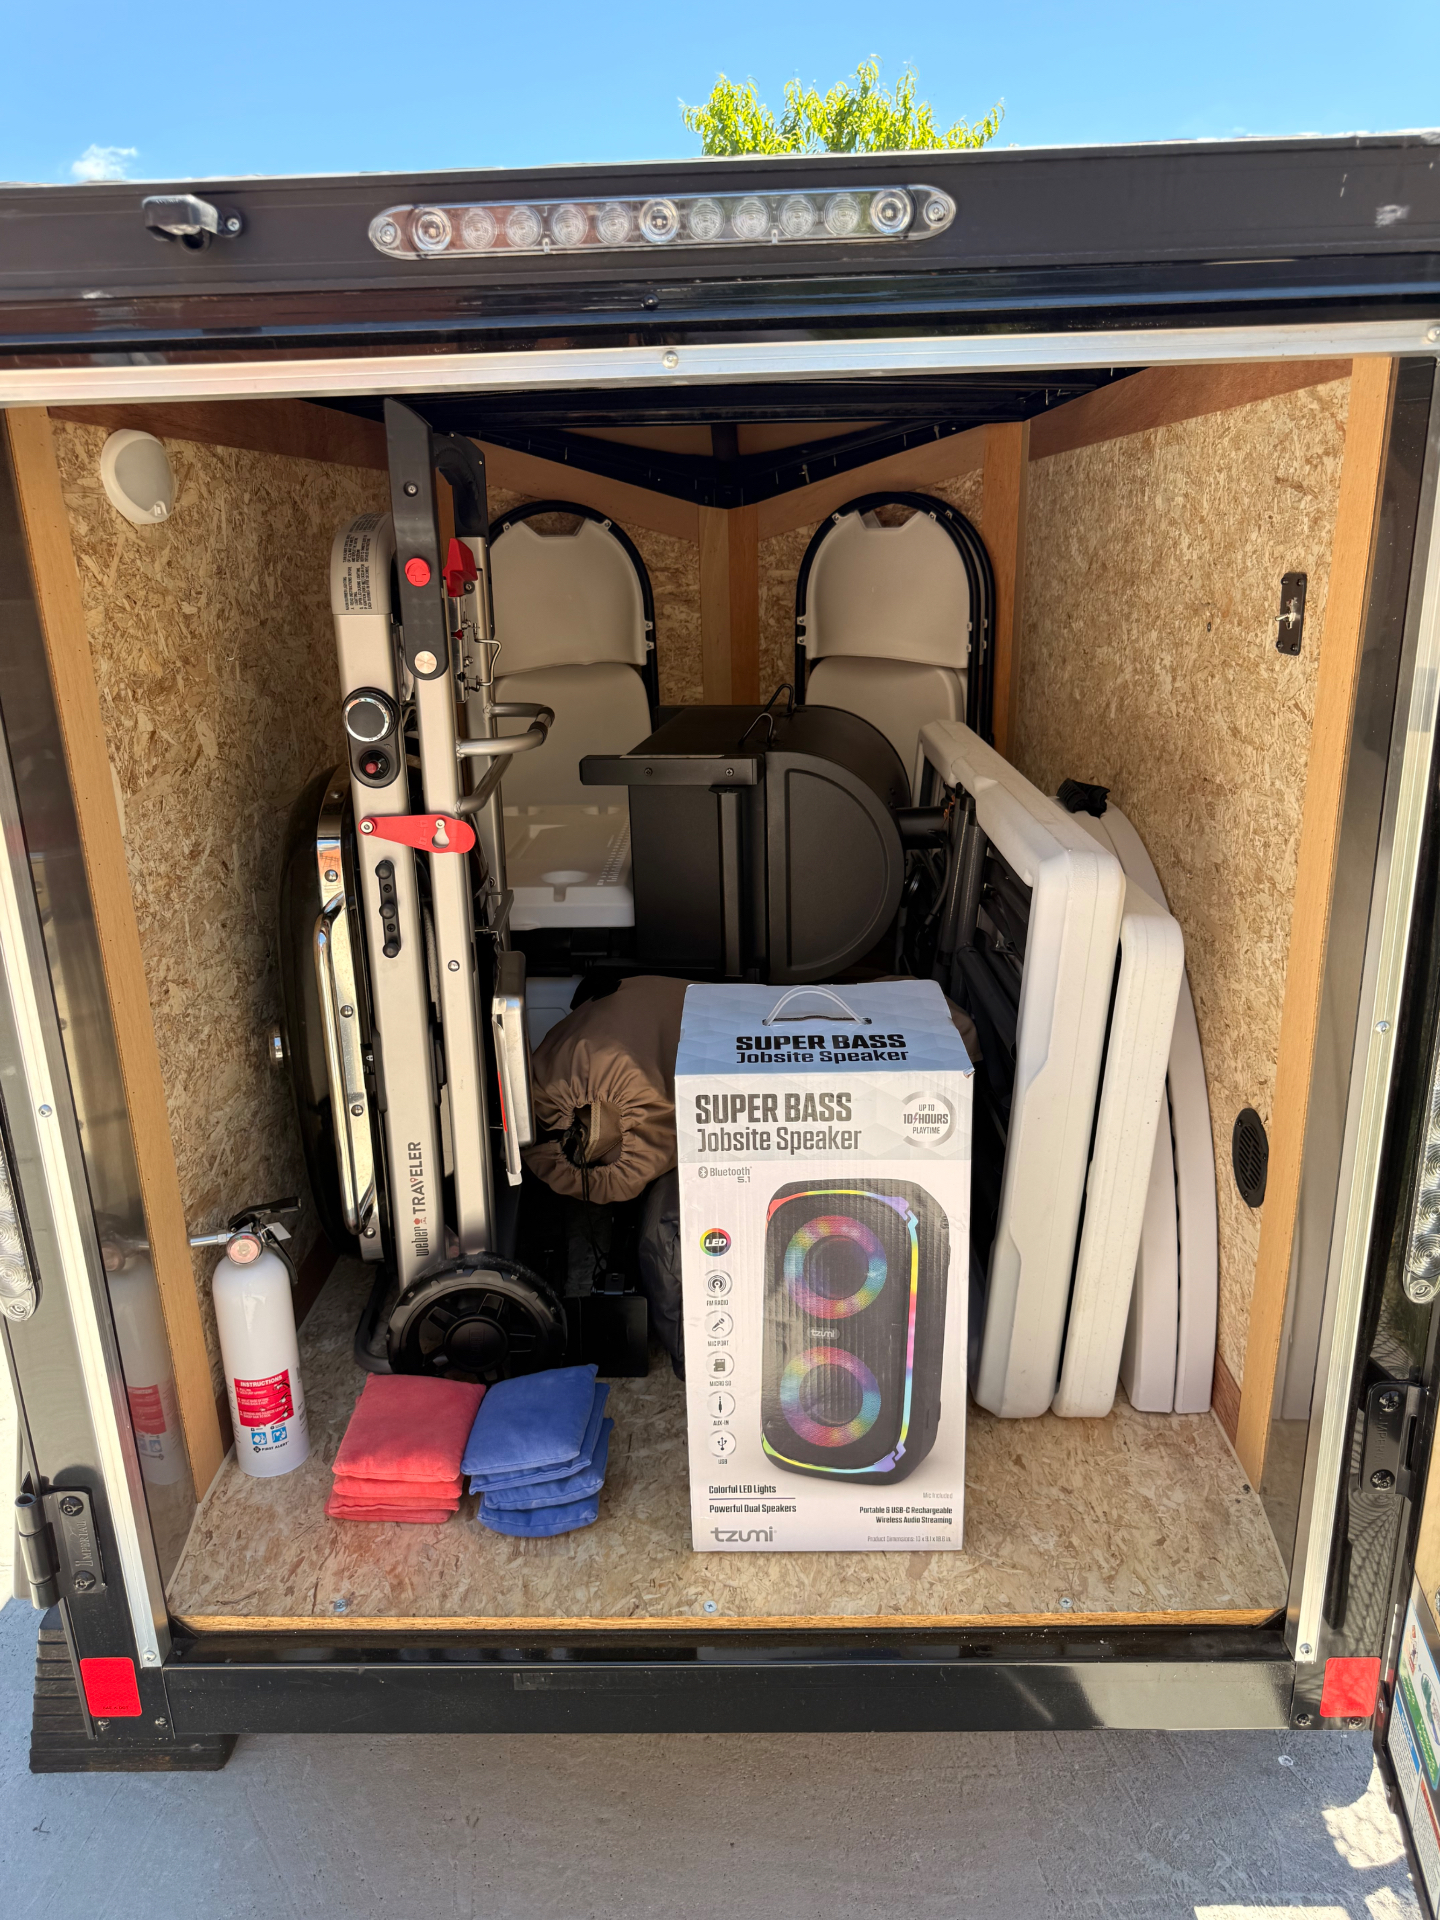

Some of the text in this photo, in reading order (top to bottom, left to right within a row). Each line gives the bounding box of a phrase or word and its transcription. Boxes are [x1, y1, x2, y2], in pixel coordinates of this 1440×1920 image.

[736, 1034, 906, 1050] SUPER BASS
[736, 1050, 908, 1064] Jobsite Speaker
[695, 1092, 852, 1124] SUPER BASS
[903, 1114, 949, 1124] 10 HOURS
[912, 1126, 940, 1134] PLAYTIME
[698, 1125, 862, 1155] Jobsite Speaker
[710, 1166, 751, 1177] Bluetooth
[408, 1141, 430, 1257] weber TRAVELER
[705, 1238, 727, 1247] LED
[240, 1375, 282, 1387] INSTRUCTIONS
[709, 1484, 777, 1495] Colorful LED Lights
[709, 1504, 796, 1514] Powerful Dual Speakers
[860, 1506, 885, 1514] Portable
[891, 1506, 910, 1514] USB-C
[911, 1506, 953, 1515] Rechargeable
[876, 1516, 953, 1524] Wireless Audio Streaming
[710, 1526, 773, 1542] tzumi
